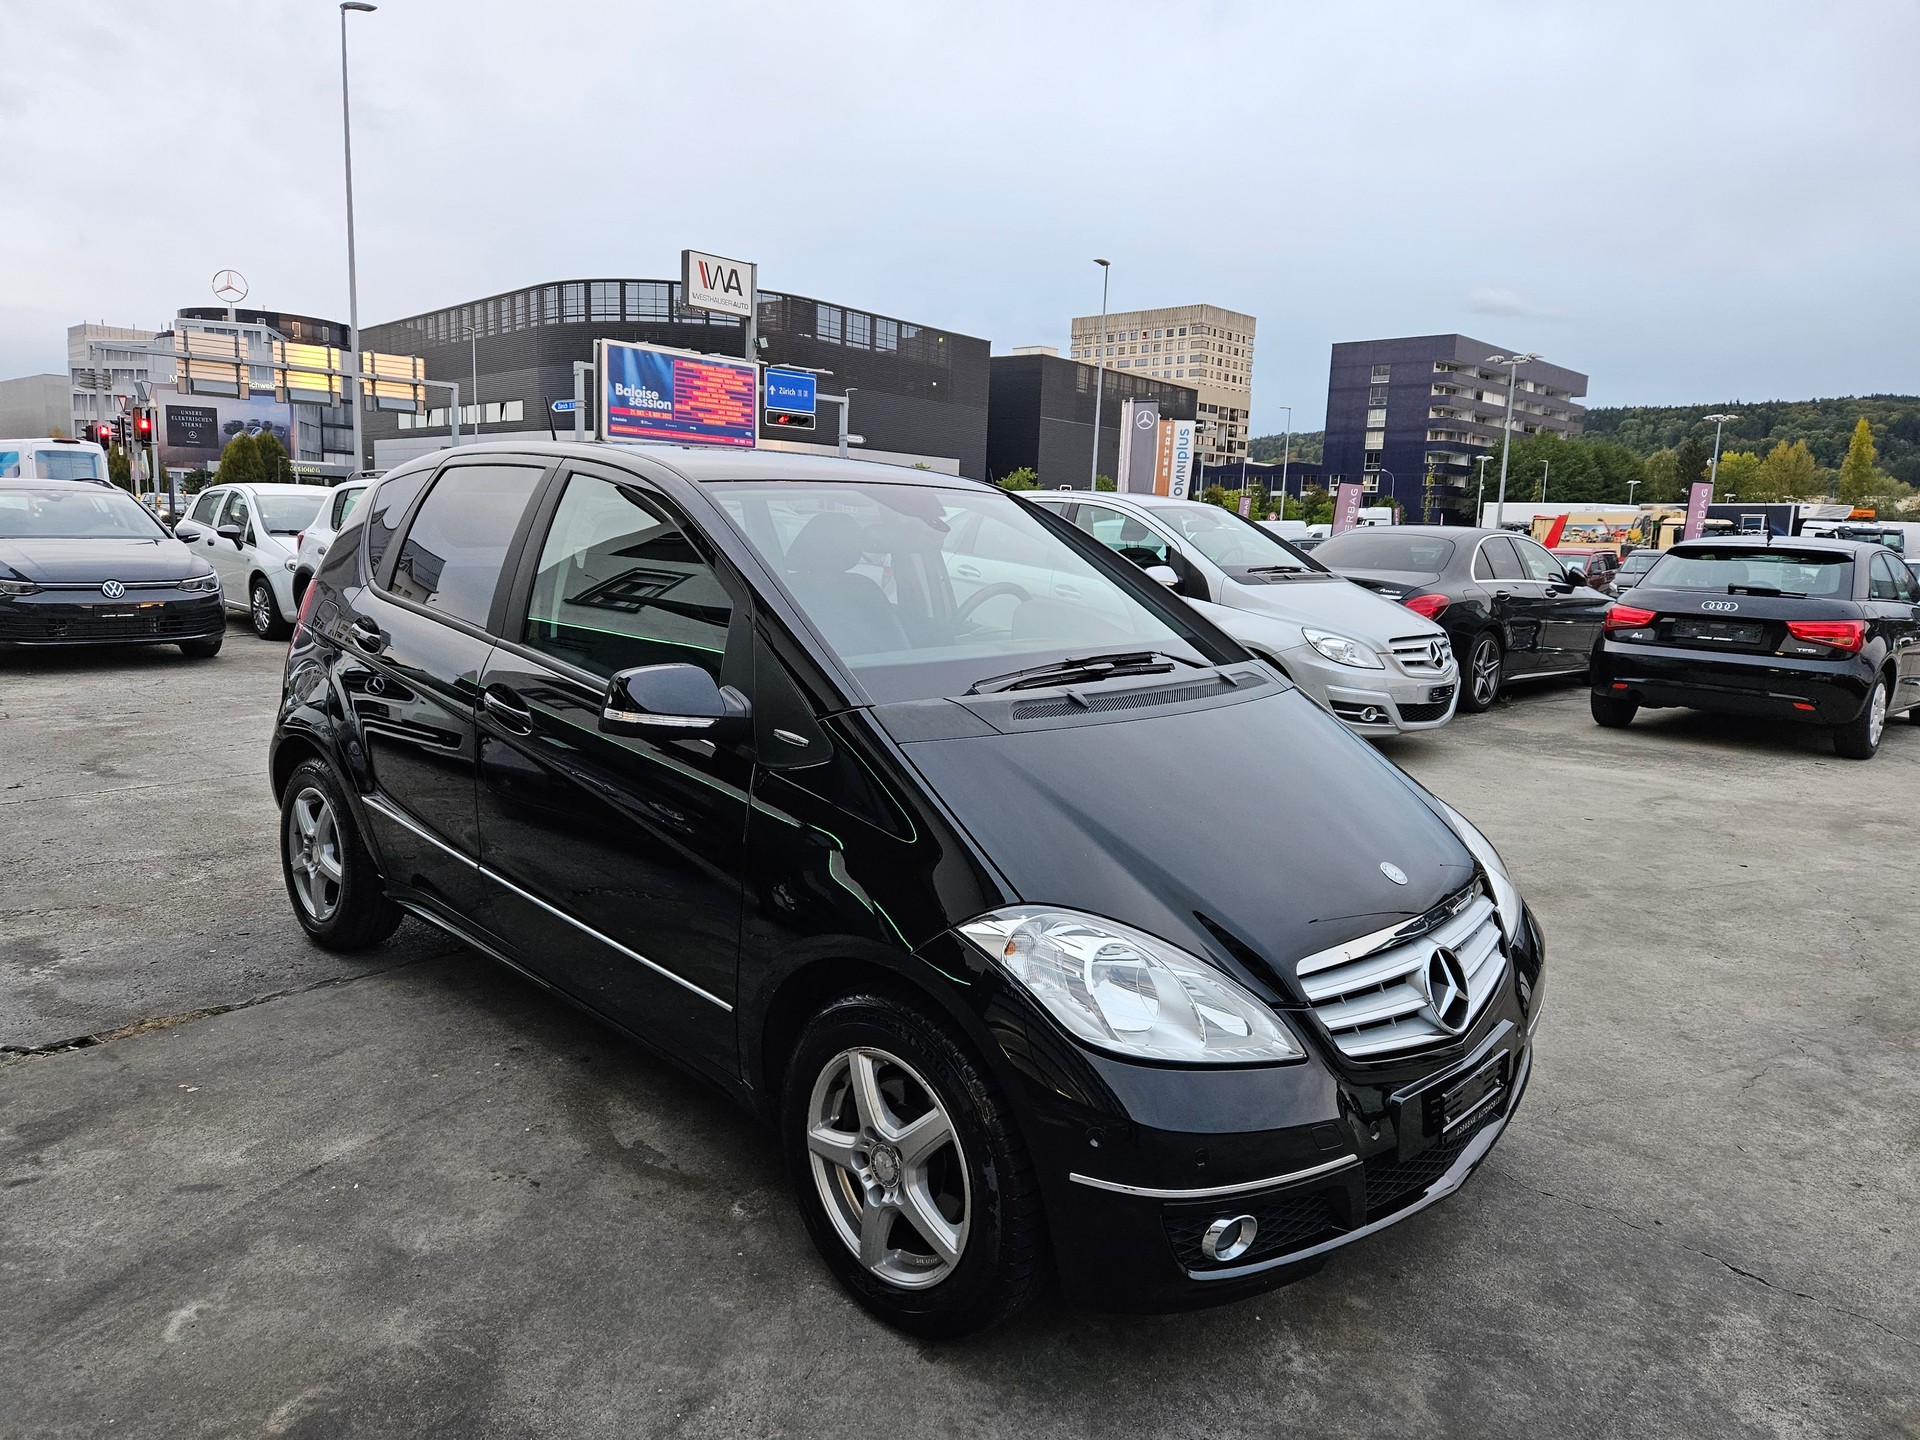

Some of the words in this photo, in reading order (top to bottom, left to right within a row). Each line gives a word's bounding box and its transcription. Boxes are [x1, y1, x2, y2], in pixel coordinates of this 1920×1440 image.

[733, 301, 749, 310] AUTO
[615, 383, 660, 400] Baloise
[778, 386, 796, 397] Zürich
[628, 396, 672, 410] session
